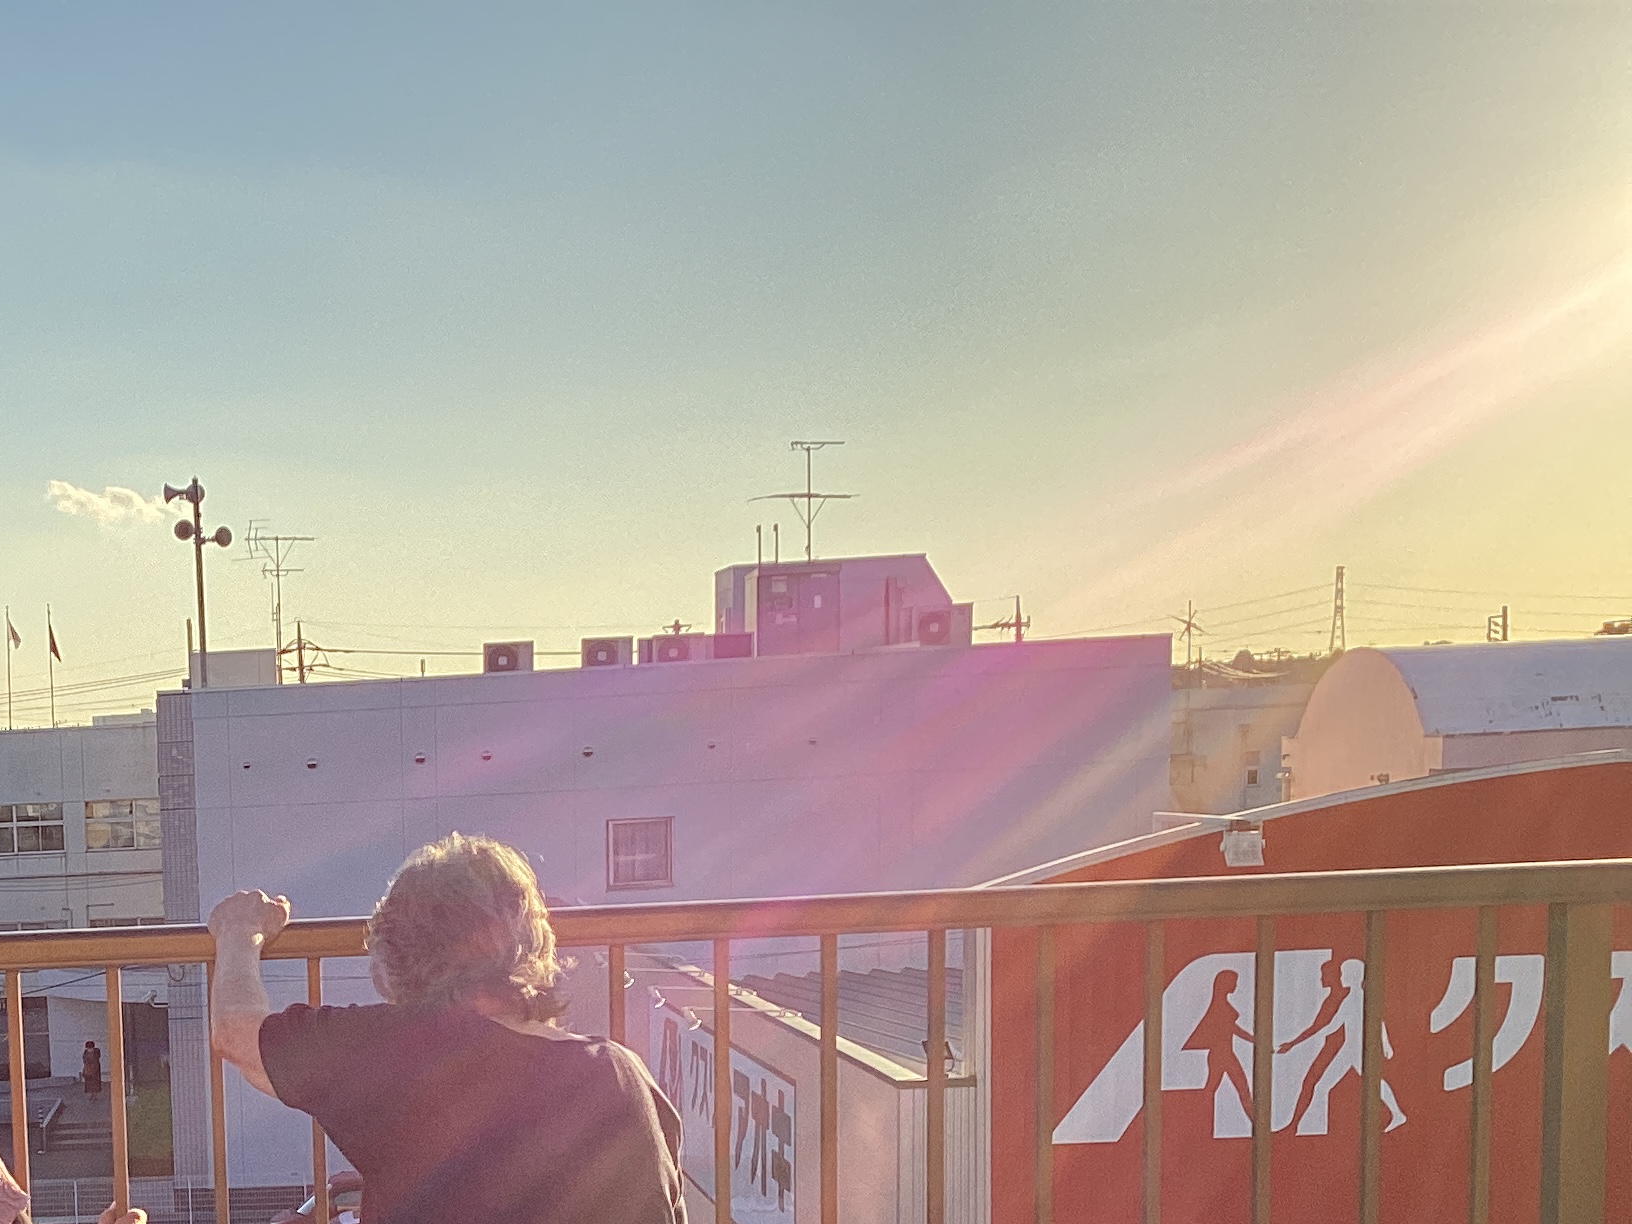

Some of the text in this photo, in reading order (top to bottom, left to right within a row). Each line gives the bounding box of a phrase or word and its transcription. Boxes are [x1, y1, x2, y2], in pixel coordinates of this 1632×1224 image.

[690, 1040, 792, 1213] クスアオキ
